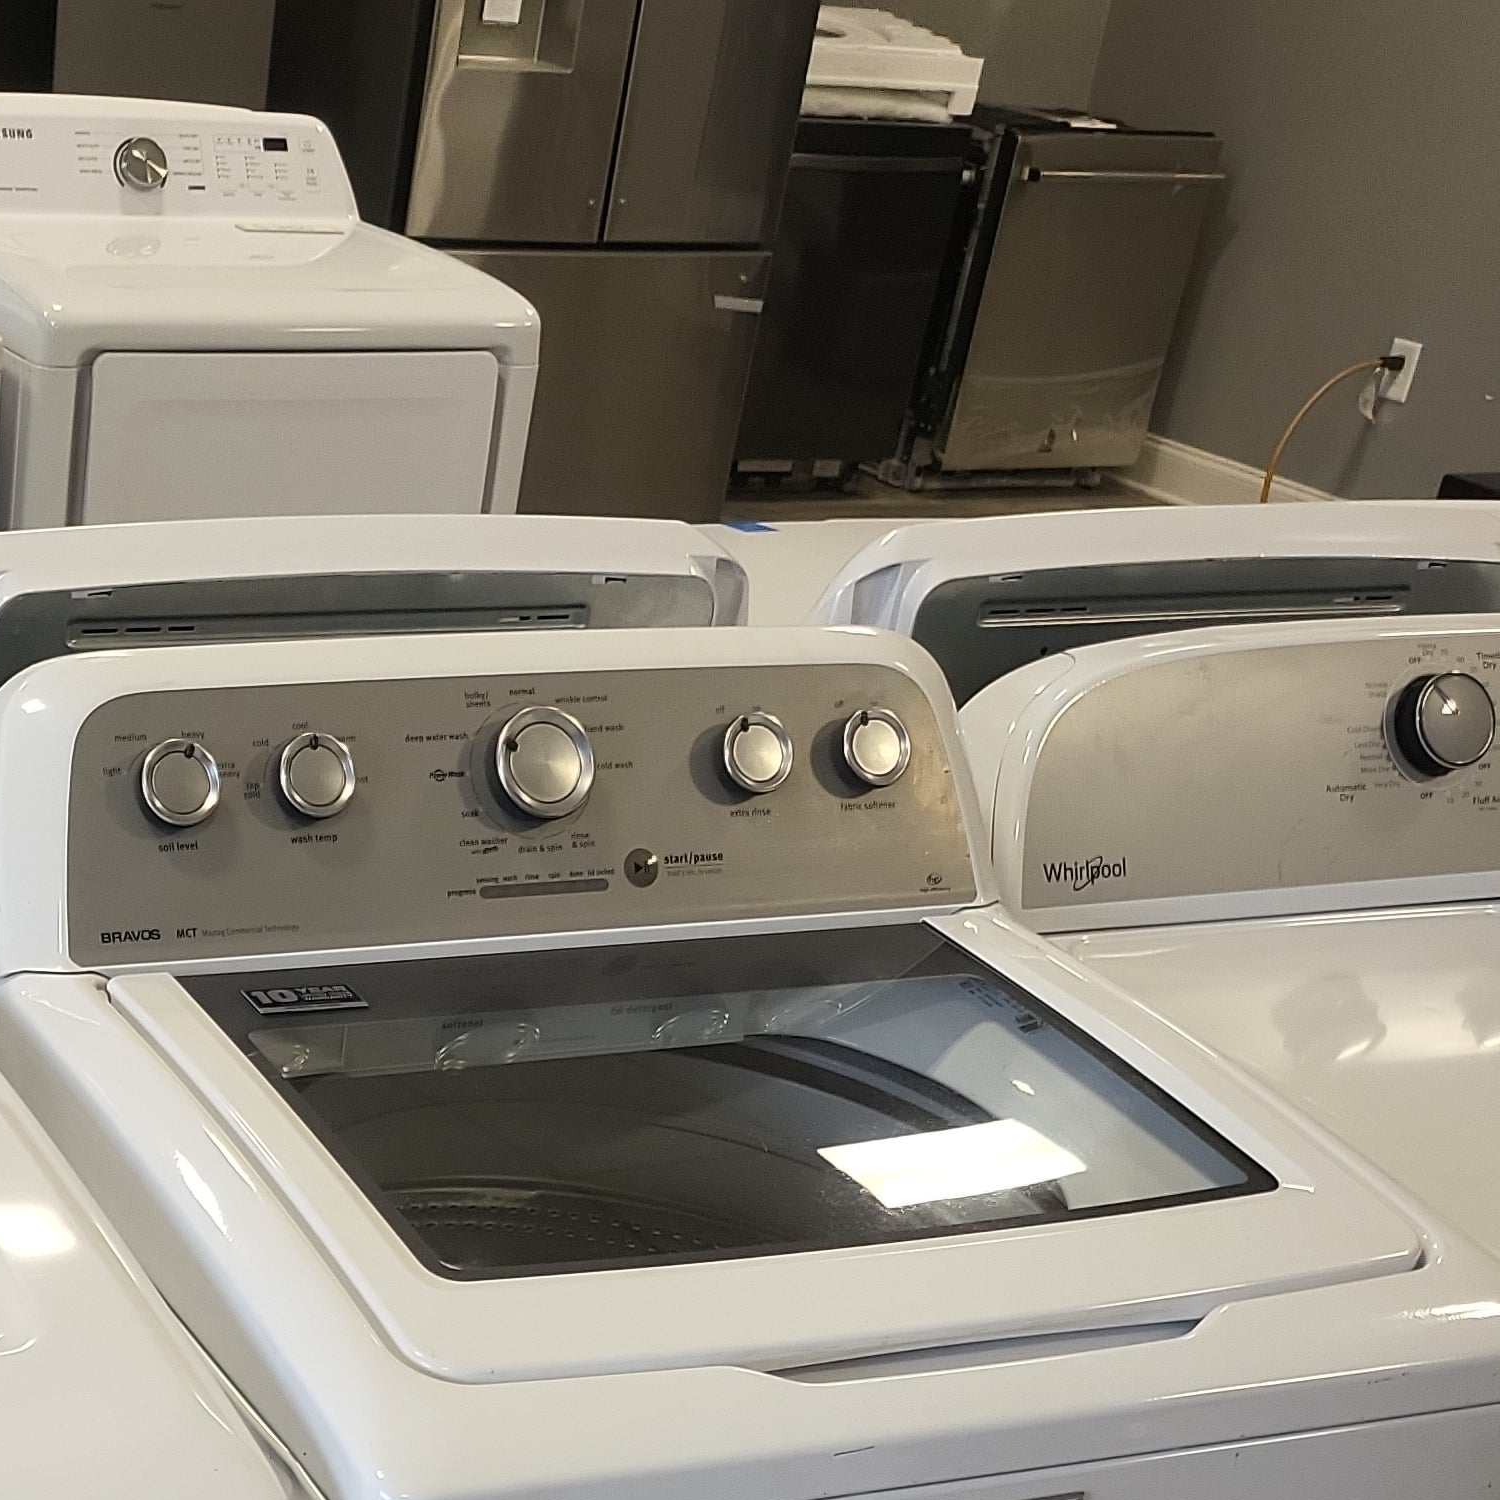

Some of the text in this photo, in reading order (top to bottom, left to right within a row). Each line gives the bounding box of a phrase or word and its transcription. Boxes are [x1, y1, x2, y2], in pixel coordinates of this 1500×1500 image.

[509, 687, 536, 697] normal
[582, 695, 608, 703] control
[291, 721, 308, 730] cool
[114, 733, 148, 743] medium
[252, 738, 269, 747] cold
[404, 734, 424, 743] deep
[425, 734, 448, 742] water
[1326, 783, 1368, 793] Automatic
[244, 790, 261, 799] cold
[1339, 793, 1355, 803] Dry
[751, 807, 772, 817] rinse
[290, 833, 338, 844] wash temp
[459, 836, 508, 847] clean washer
[158, 841, 199, 852] soil level
[518, 845, 537, 854] drain
[664, 851, 724, 864] start/pause
[1043, 856, 1127, 891] Whirlpool
[100, 928, 161, 944] BRAVOS
[176, 927, 198, 940] MCT
[251, 989, 299, 1004] 10
